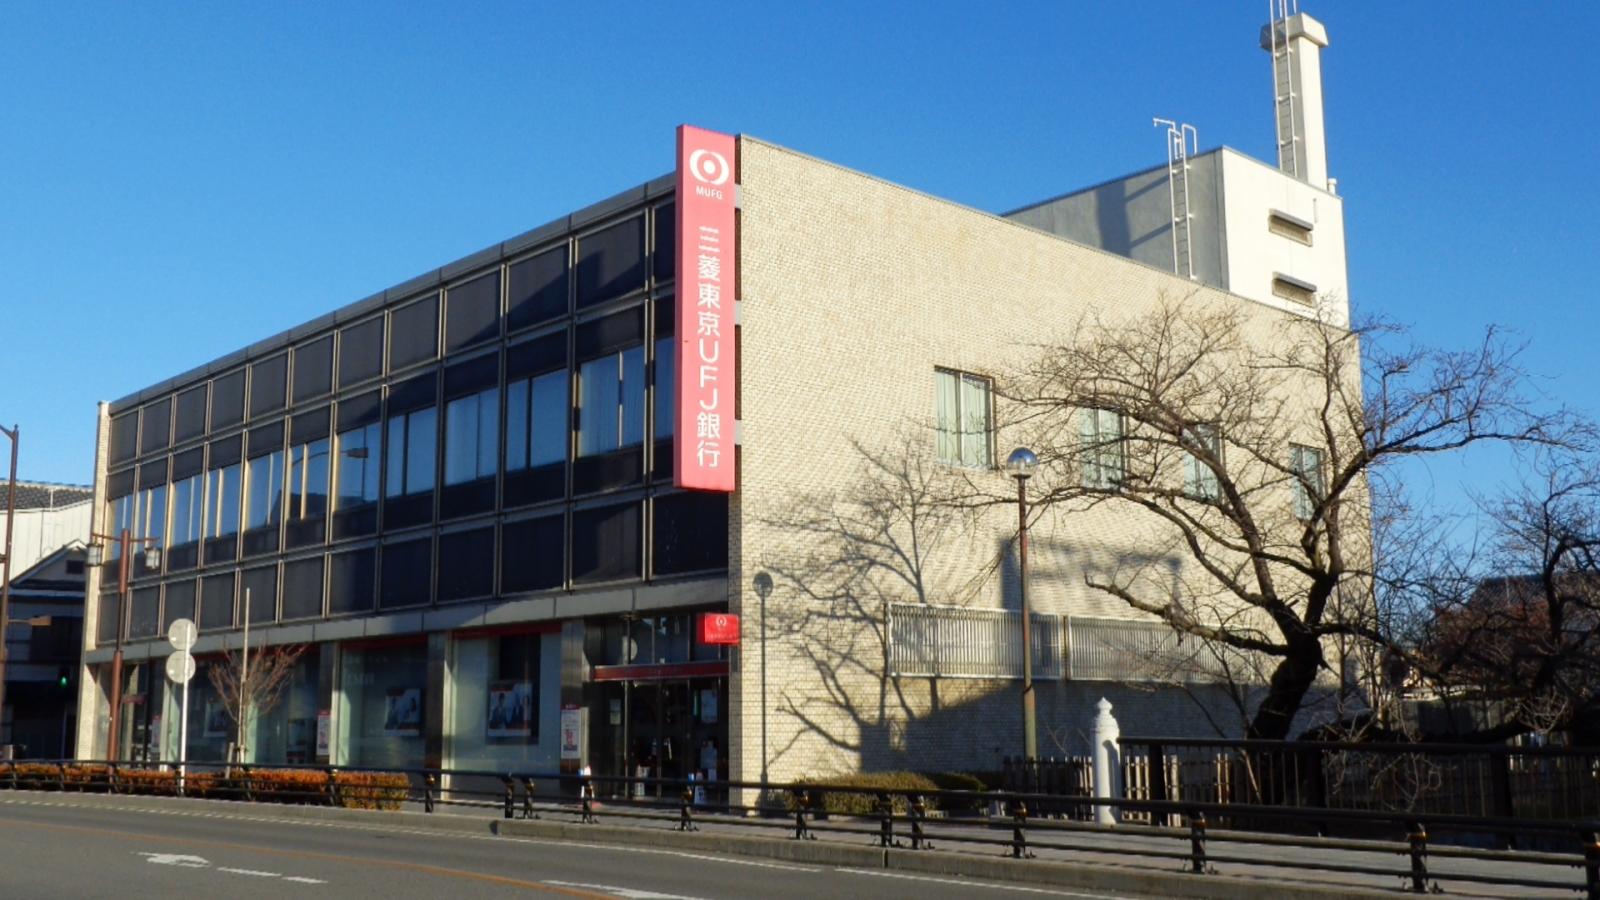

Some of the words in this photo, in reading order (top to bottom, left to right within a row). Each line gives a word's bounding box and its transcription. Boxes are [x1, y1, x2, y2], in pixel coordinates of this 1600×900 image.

[696, 185, 722, 199] MUFG
[697, 226, 720, 467] 三菱東京UFJ銀行
